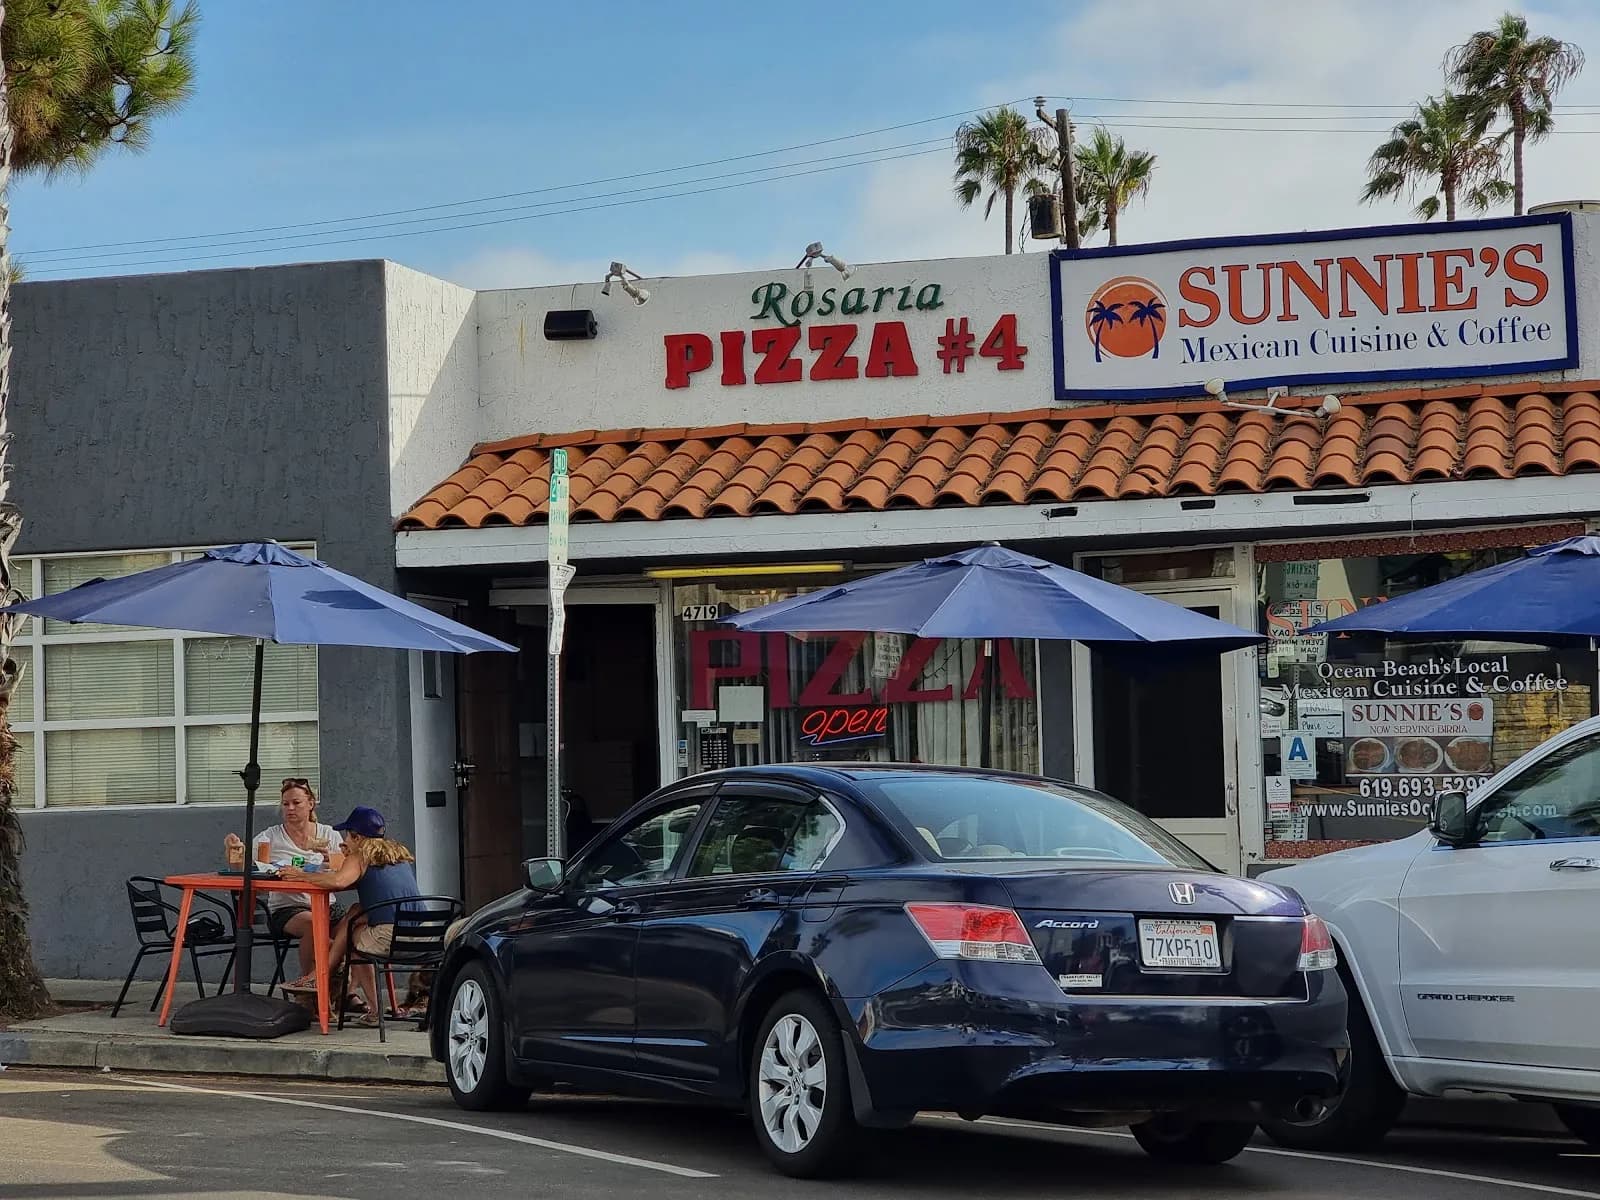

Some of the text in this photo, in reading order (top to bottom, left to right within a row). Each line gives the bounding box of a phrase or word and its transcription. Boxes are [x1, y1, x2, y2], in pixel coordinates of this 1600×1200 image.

[1178, 243, 1549, 328] SUNNIE'S
[750, 280, 944, 327] Rosaria
[664, 314, 1028, 389] PIZZA #4
[1178, 317, 1551, 364] Mexican Cuisine & Coffee
[683, 606, 717, 620] 4719
[691, 631, 1035, 708] PIZZA
[1318, 656, 1508, 681] Ocean Beach's Local
[1280, 673, 1569, 700] Mexican Cuisine & Coffee
[802, 708, 887, 742] open
[1351, 703, 1463, 722] SUNNIE'S
[1369, 724, 1468, 734] NOW SERVING BIRRIA
[1288, 737, 1308, 761] A
[1035, 919, 1099, 929] Accord
[1156, 924, 1198, 936] California
[1417, 993, 1515, 1002] GRAND CHEROKEE
